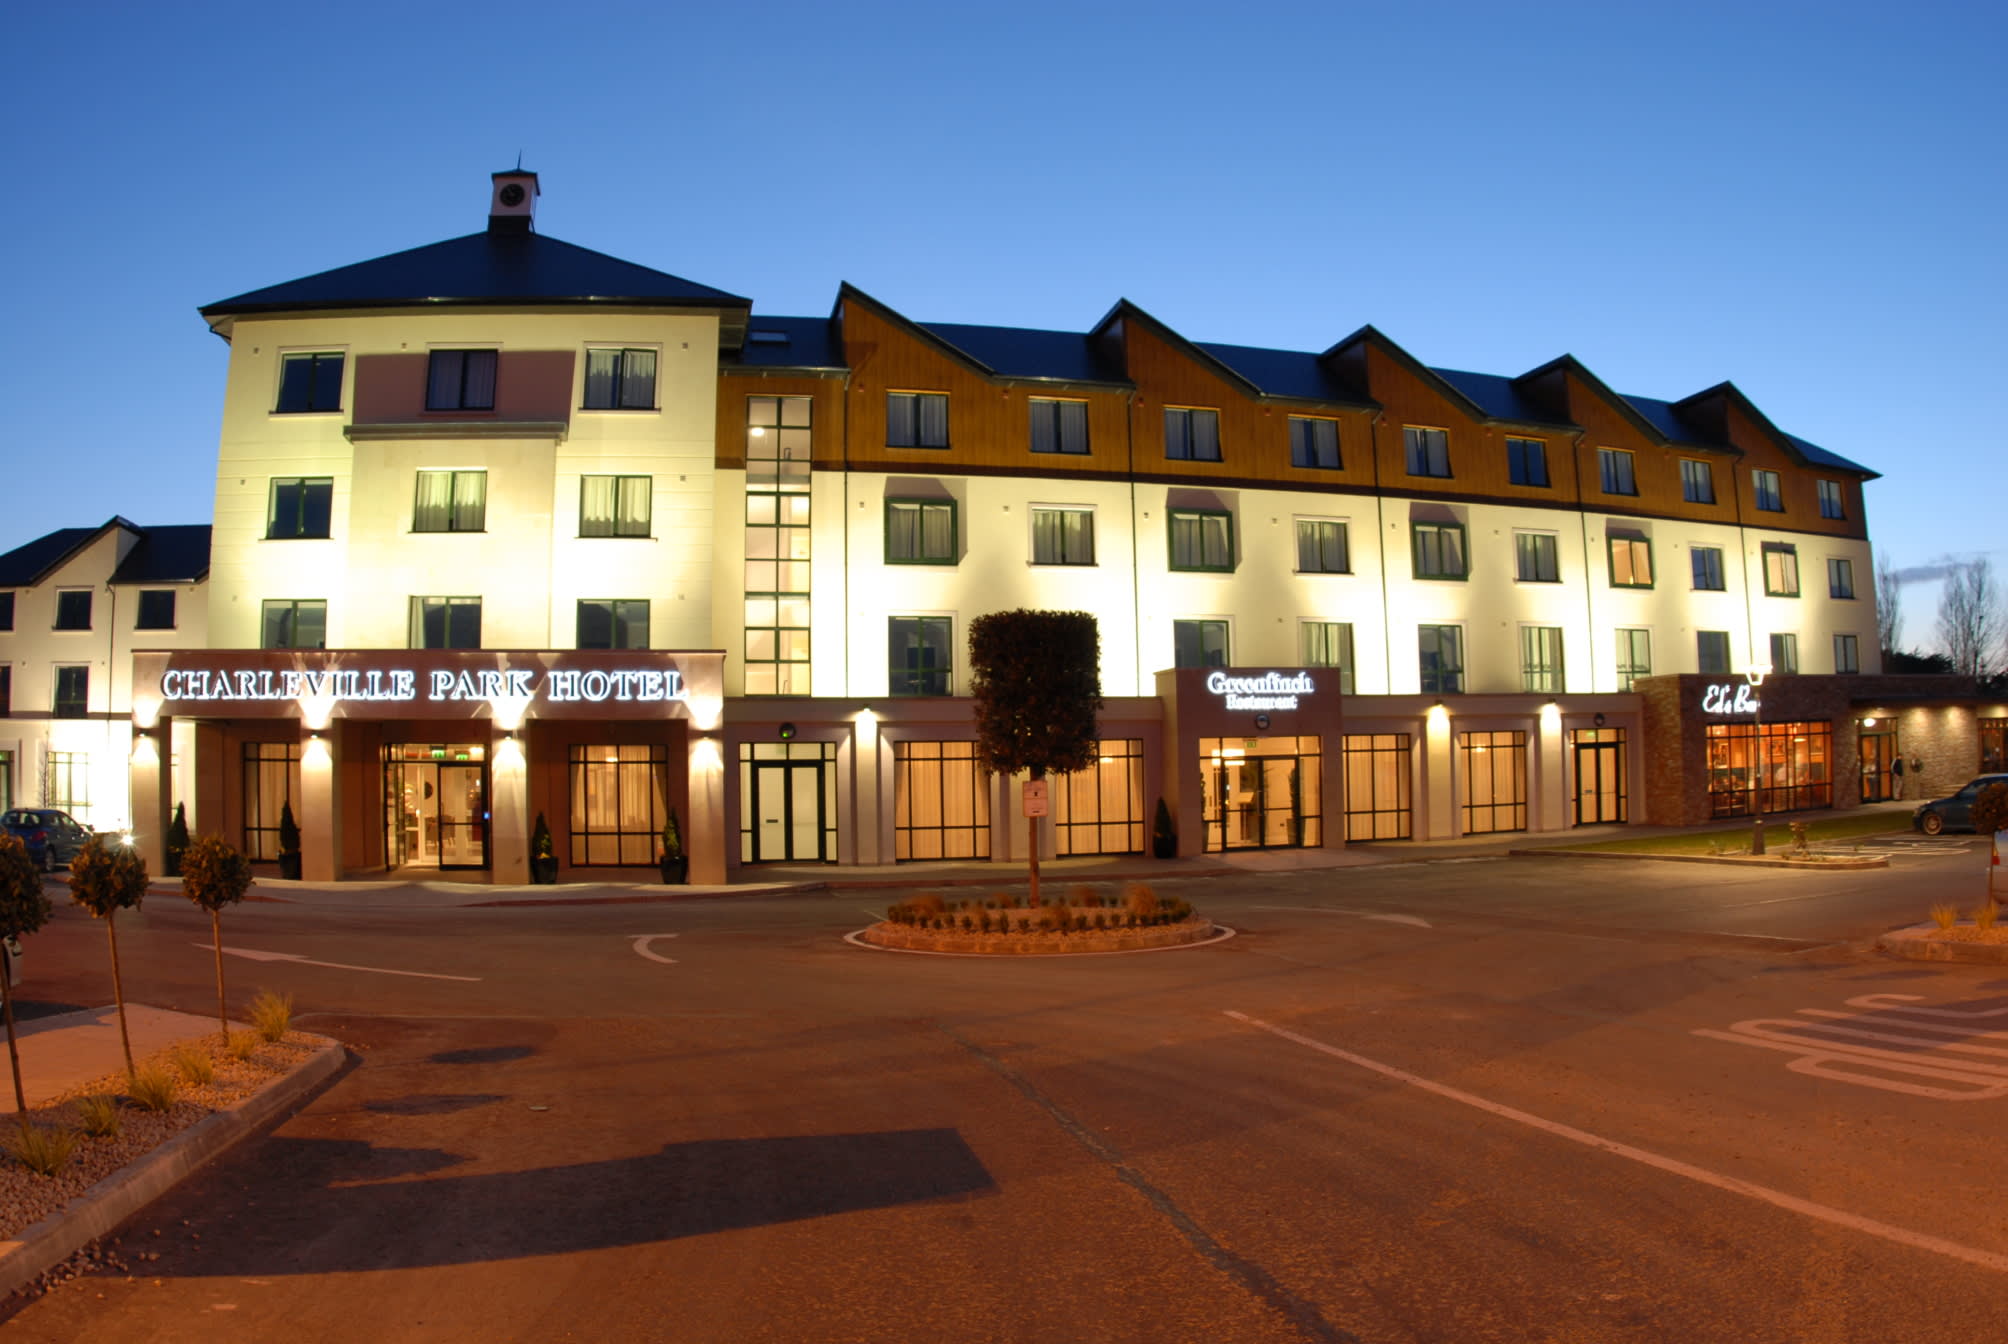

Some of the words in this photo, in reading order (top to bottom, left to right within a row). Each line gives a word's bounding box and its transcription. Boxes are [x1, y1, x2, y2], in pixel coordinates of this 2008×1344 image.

[162, 669, 415, 700] CHARLEVILLE
[429, 669, 534, 701] PARK
[547, 669, 690, 701] HOTEL
[1226, 694, 1298, 710] Restaurant
